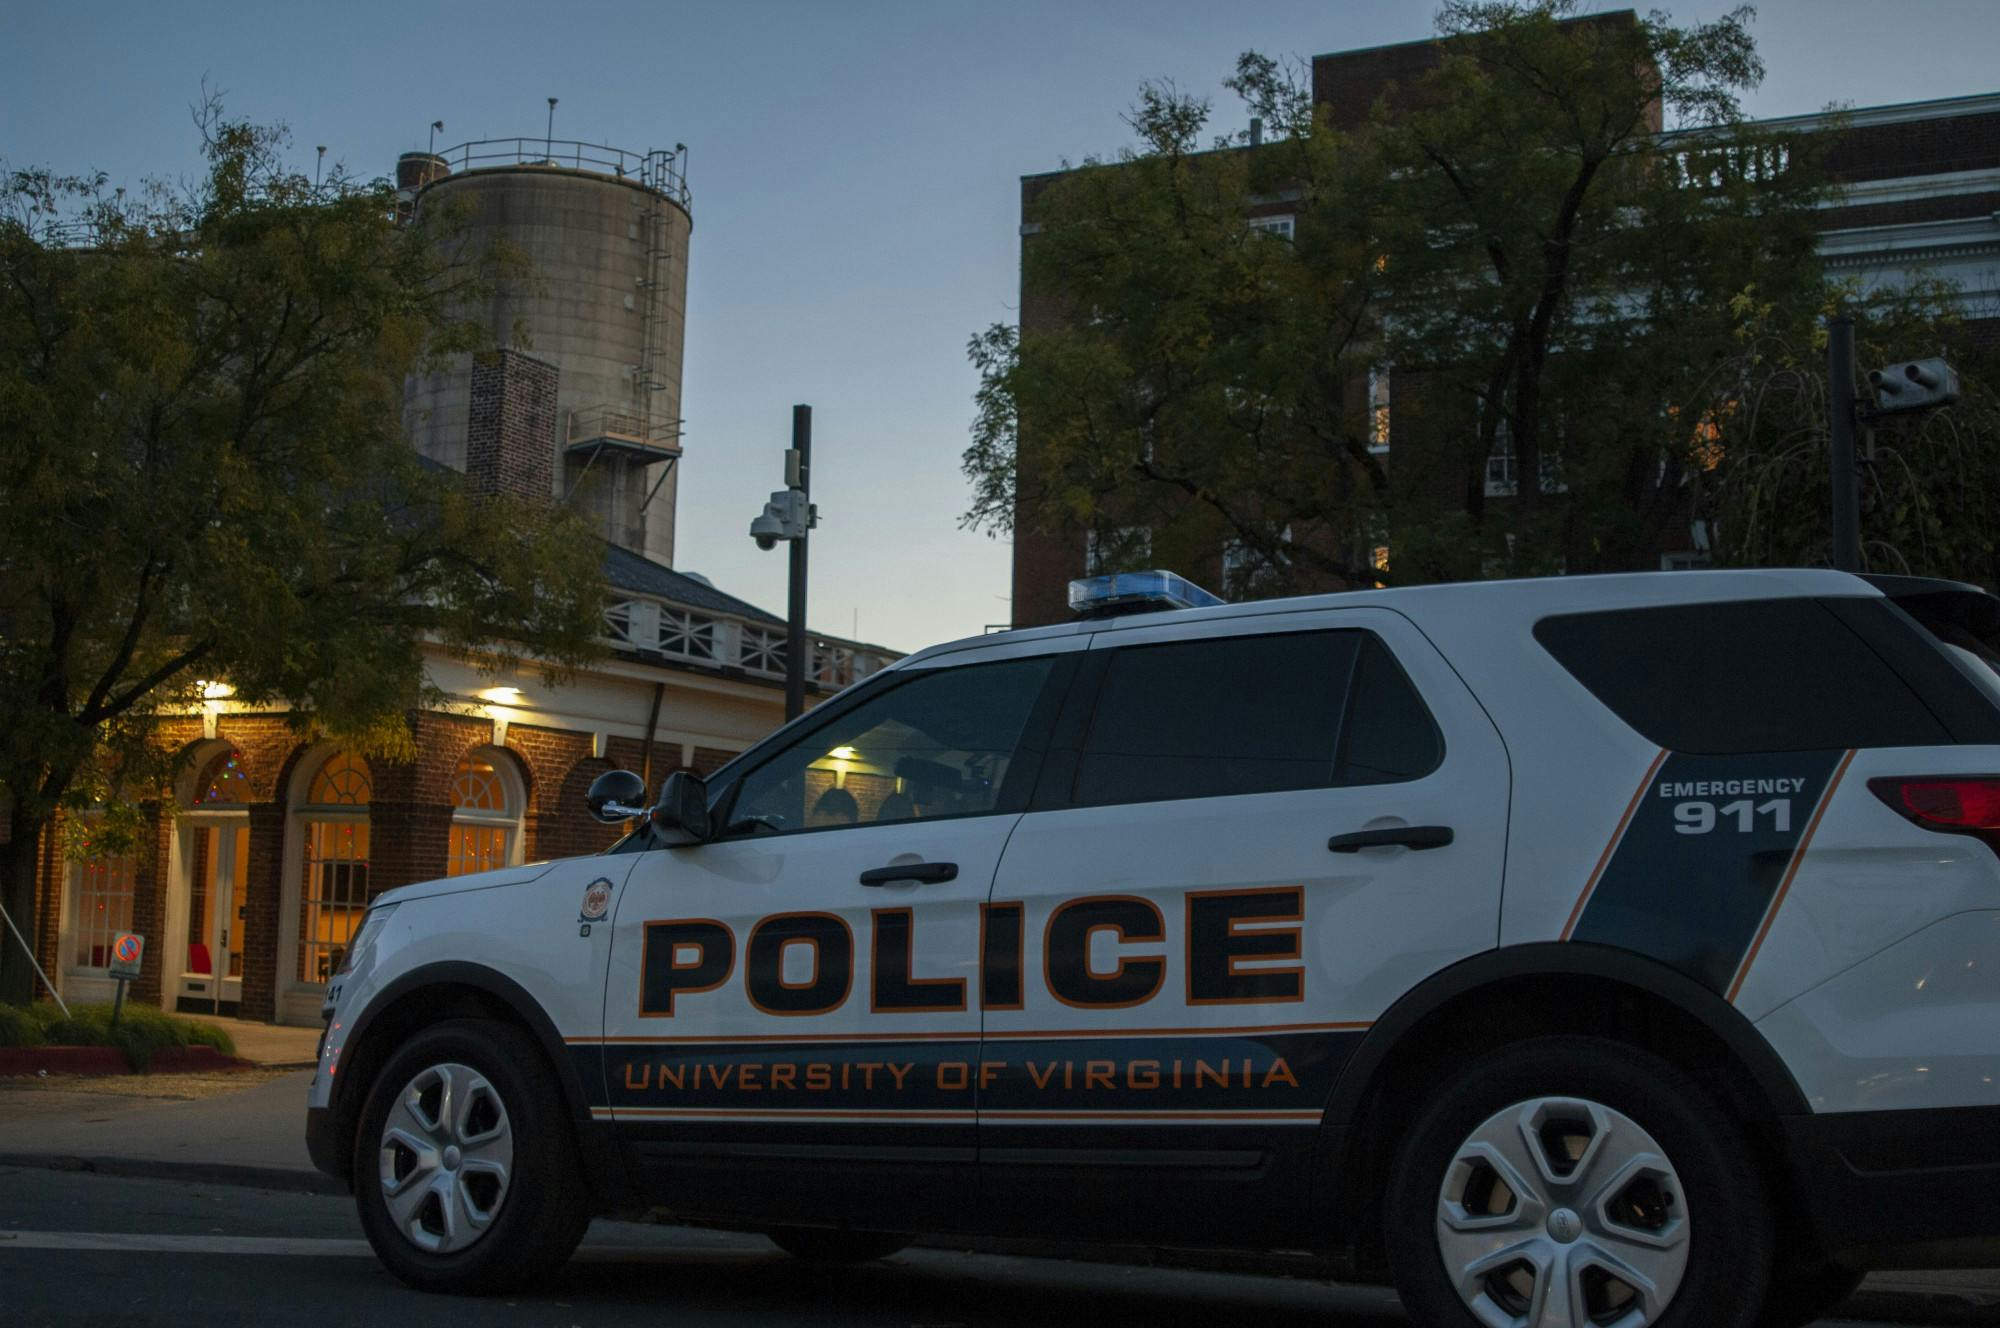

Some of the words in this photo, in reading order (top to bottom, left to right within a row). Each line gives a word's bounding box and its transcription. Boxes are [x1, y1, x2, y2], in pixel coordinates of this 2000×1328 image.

[1659, 777, 1806, 798] EMERGENCY
[1673, 798, 1791, 835] 911
[638, 885, 1305, 1018] POLICE
[624, 1061, 916, 1091] UNIVERSITY
[935, 1060, 1008, 1091] OF
[1025, 1056, 1300, 1090] VIRGINIA
